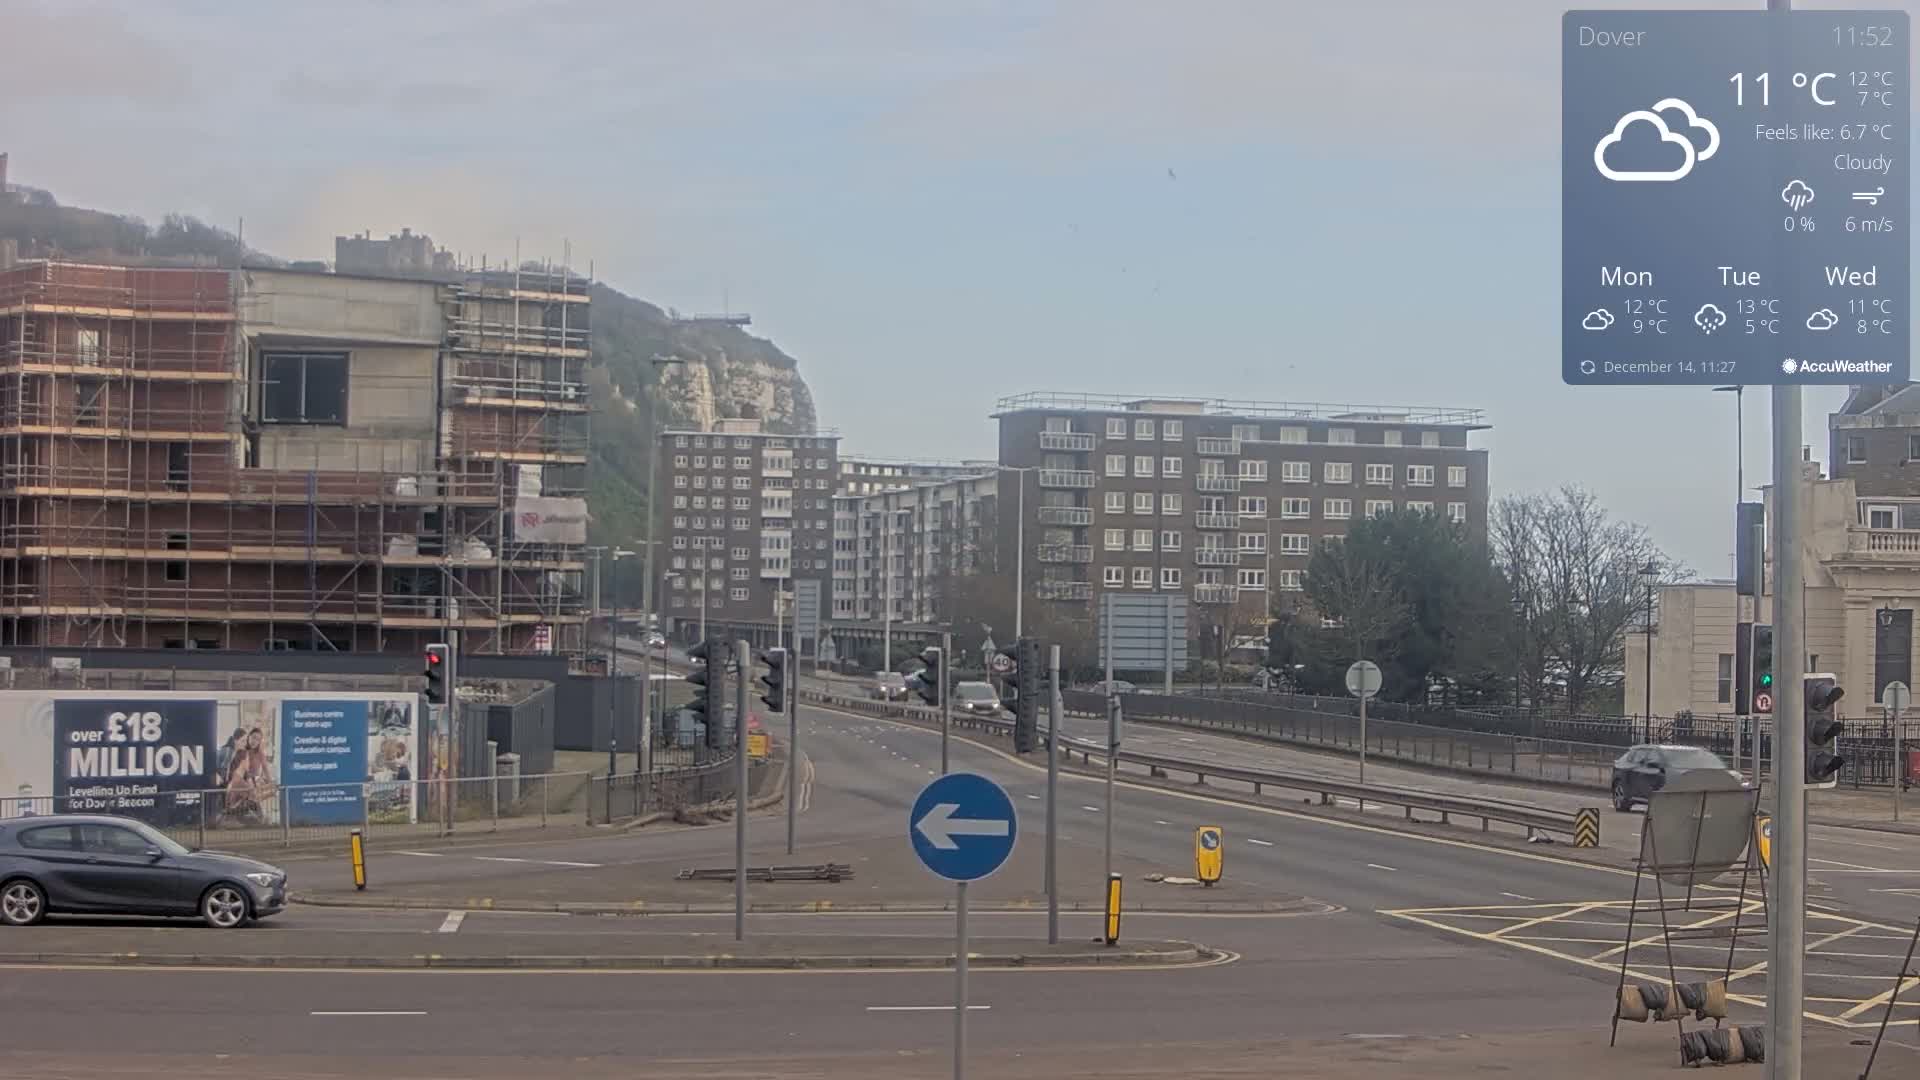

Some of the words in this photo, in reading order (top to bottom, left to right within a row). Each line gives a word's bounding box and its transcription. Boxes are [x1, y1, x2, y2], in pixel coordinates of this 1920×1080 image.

[71, 730, 104, 742] over
[108, 711, 162, 742] £18
[70, 745, 204, 777] MILLION
[132, 784, 158, 795] Fund
[118, 797, 155, 808] Beacon
